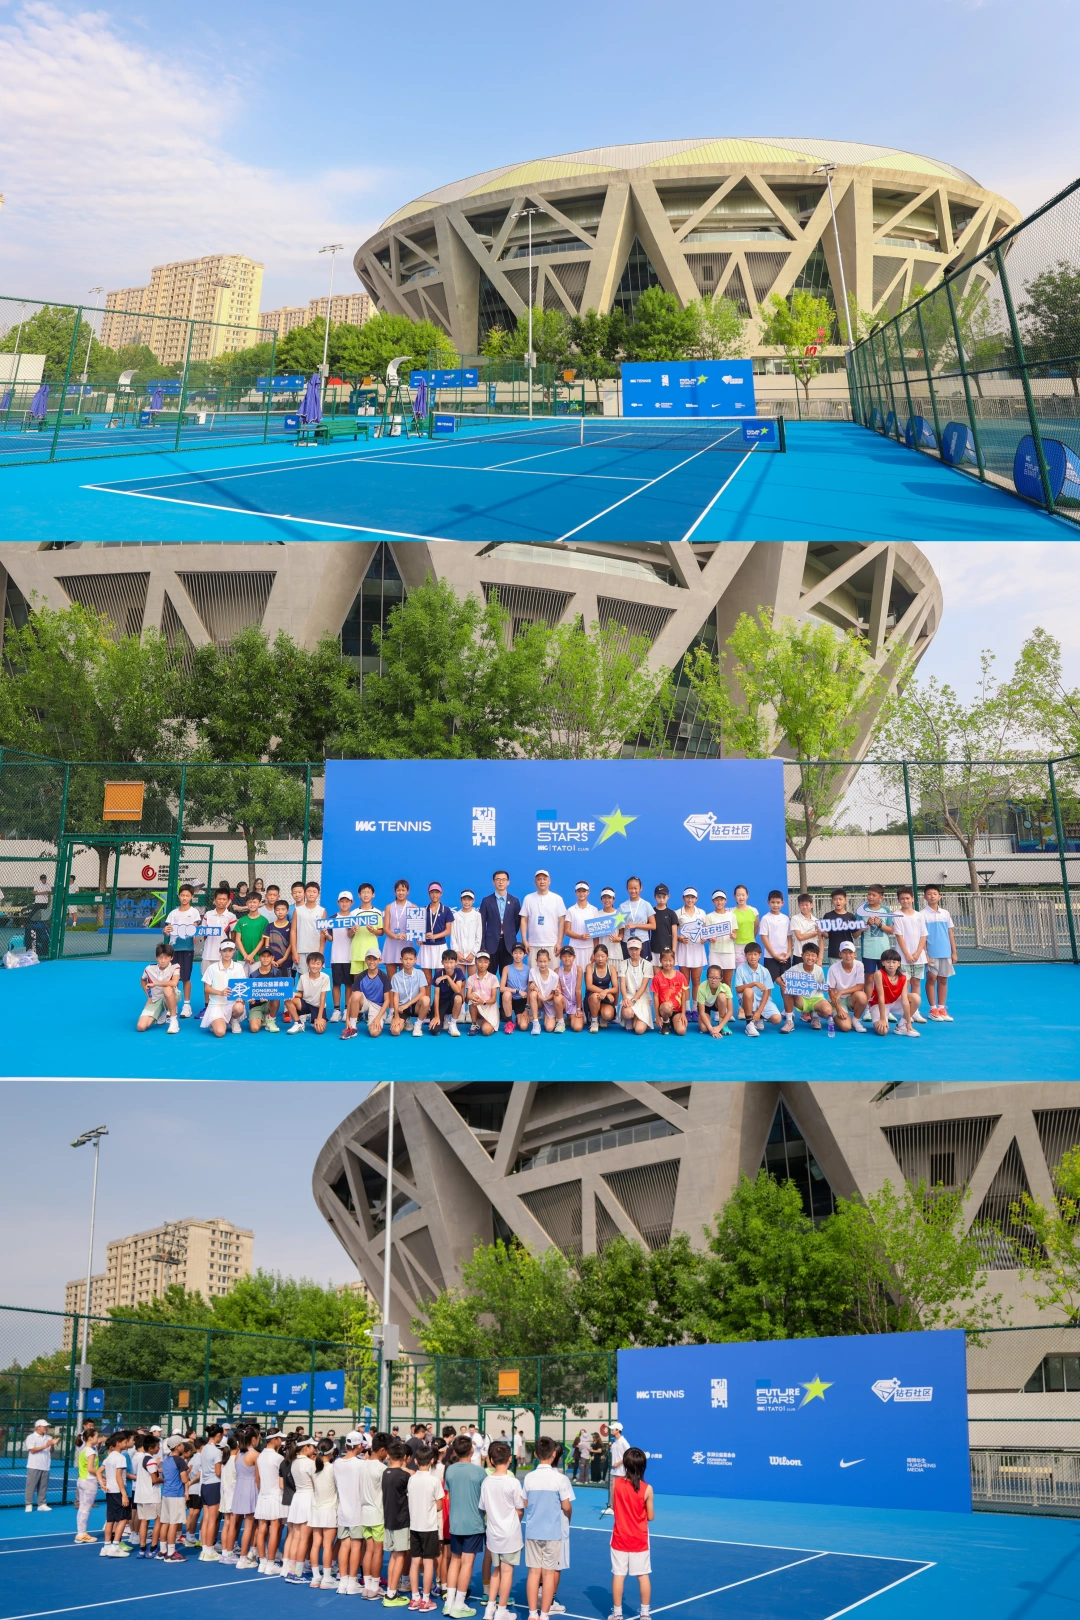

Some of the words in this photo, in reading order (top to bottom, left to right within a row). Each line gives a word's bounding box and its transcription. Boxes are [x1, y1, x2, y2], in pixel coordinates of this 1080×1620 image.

[378, 821, 432, 832] TENNIS
[537, 822, 595, 832] FUTURE
[711, 825, 751, 836] 钻石社区
[537, 832, 588, 842] STARS
[337, 915, 378, 927] TENNIS
[818, 917, 866, 932] Wilson
[701, 923, 730, 936] 钻石社区
[785, 979, 829, 991] HUASHENG
[784, 987, 811, 997] MEDIA
[651, 1390, 685, 1399] TENNIS
[756, 1388, 800, 1396] FUTURE
[896, 1388, 932, 1397] 钻石社区
[756, 1396, 795, 1404] STARS
[769, 1456, 802, 1466] Wilson
